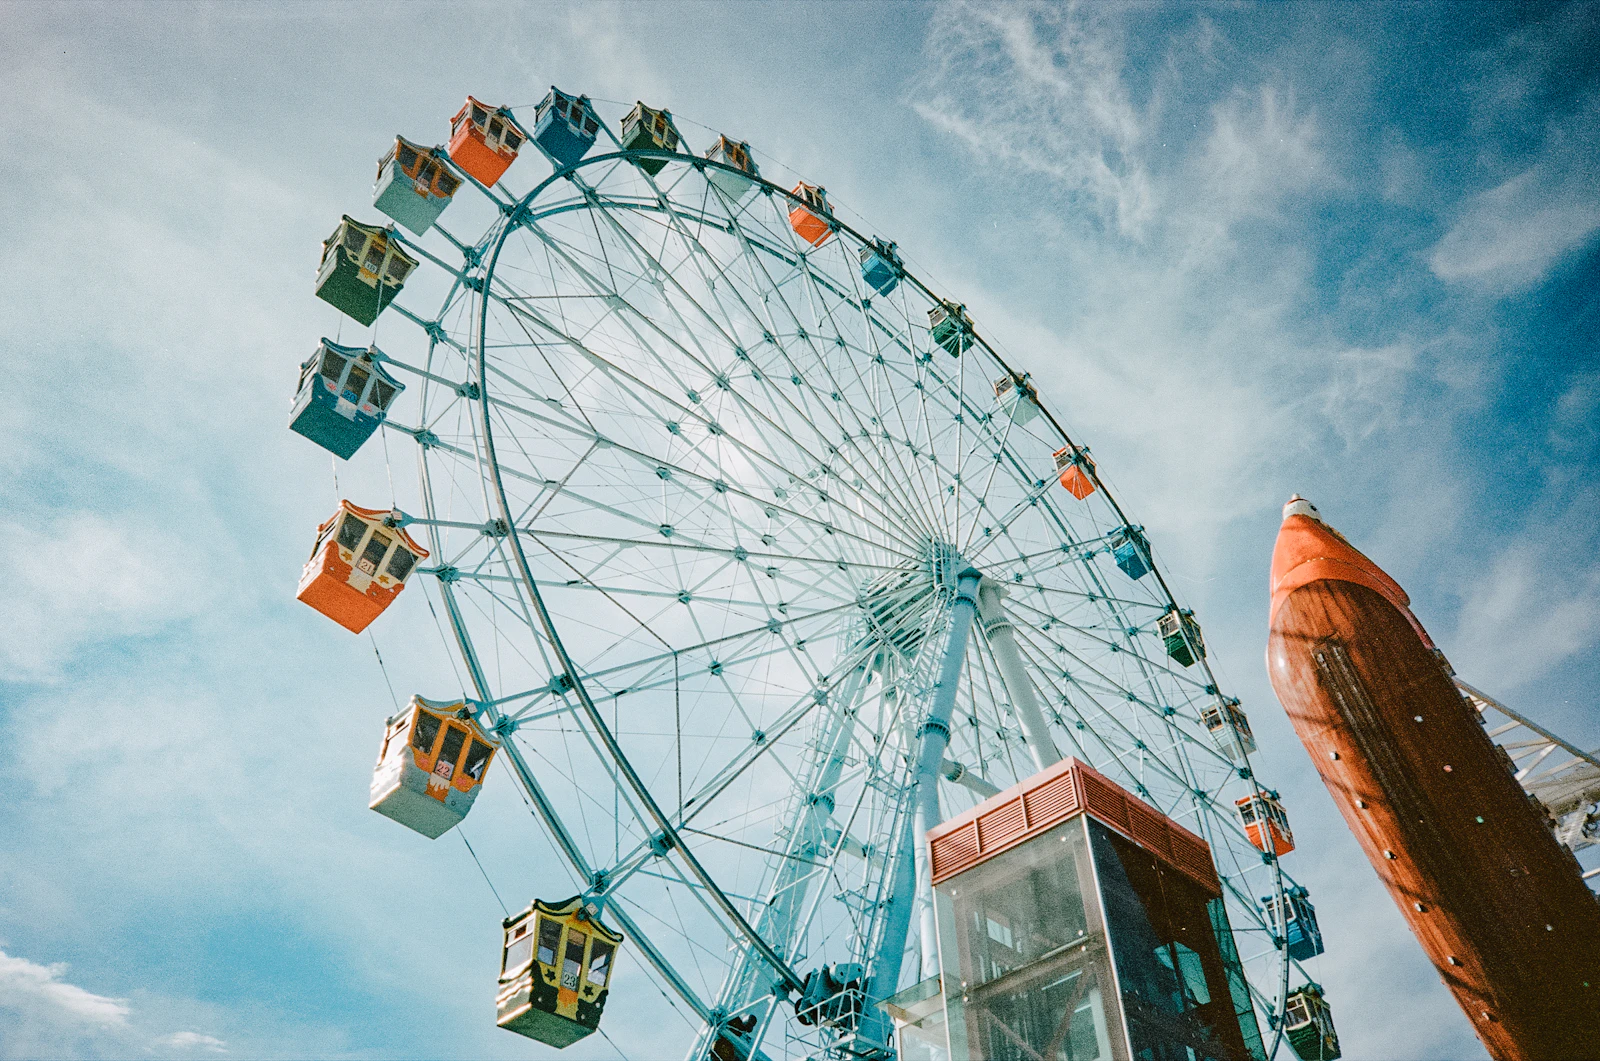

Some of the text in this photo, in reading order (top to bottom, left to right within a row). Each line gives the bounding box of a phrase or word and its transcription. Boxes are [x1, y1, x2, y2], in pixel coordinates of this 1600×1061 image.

[361, 561, 372, 572] 21
[437, 763, 450, 779] 22
[563, 973, 576, 988] 23
